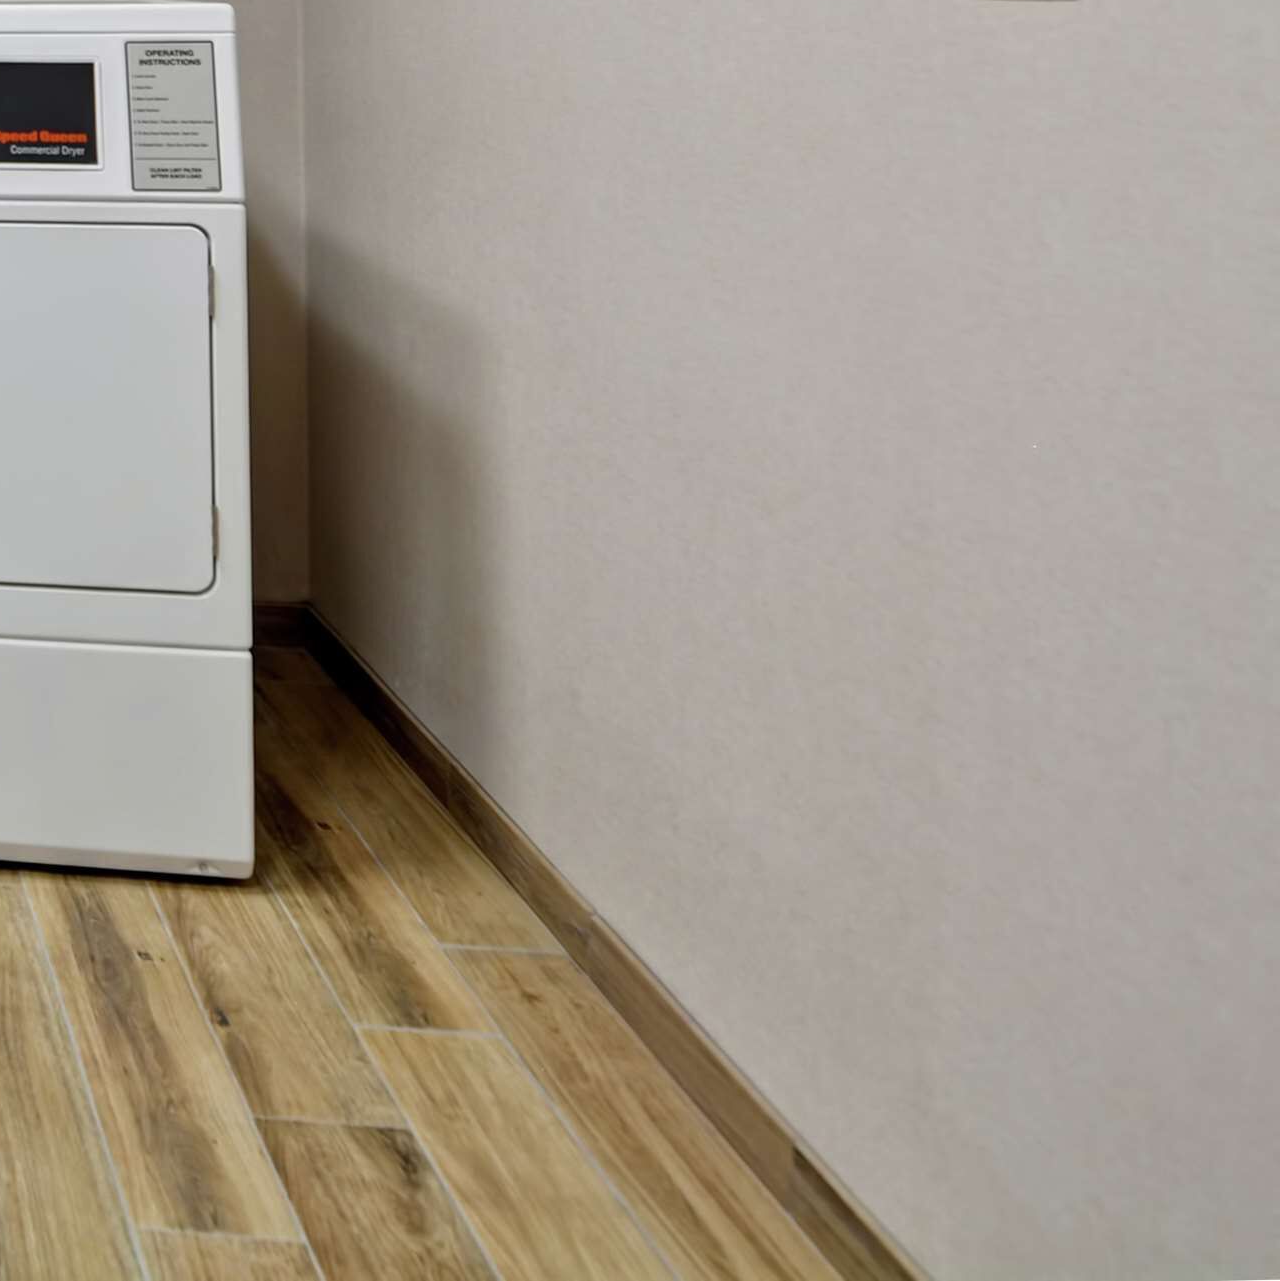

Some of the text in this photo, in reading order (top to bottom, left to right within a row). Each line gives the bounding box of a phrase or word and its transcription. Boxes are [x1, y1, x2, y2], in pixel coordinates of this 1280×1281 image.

[144, 49, 195, 58] OPERATING
[138, 58, 202, 67] INSTRUCTIONS
[10, 144, 86, 158] Commercial Dryer
